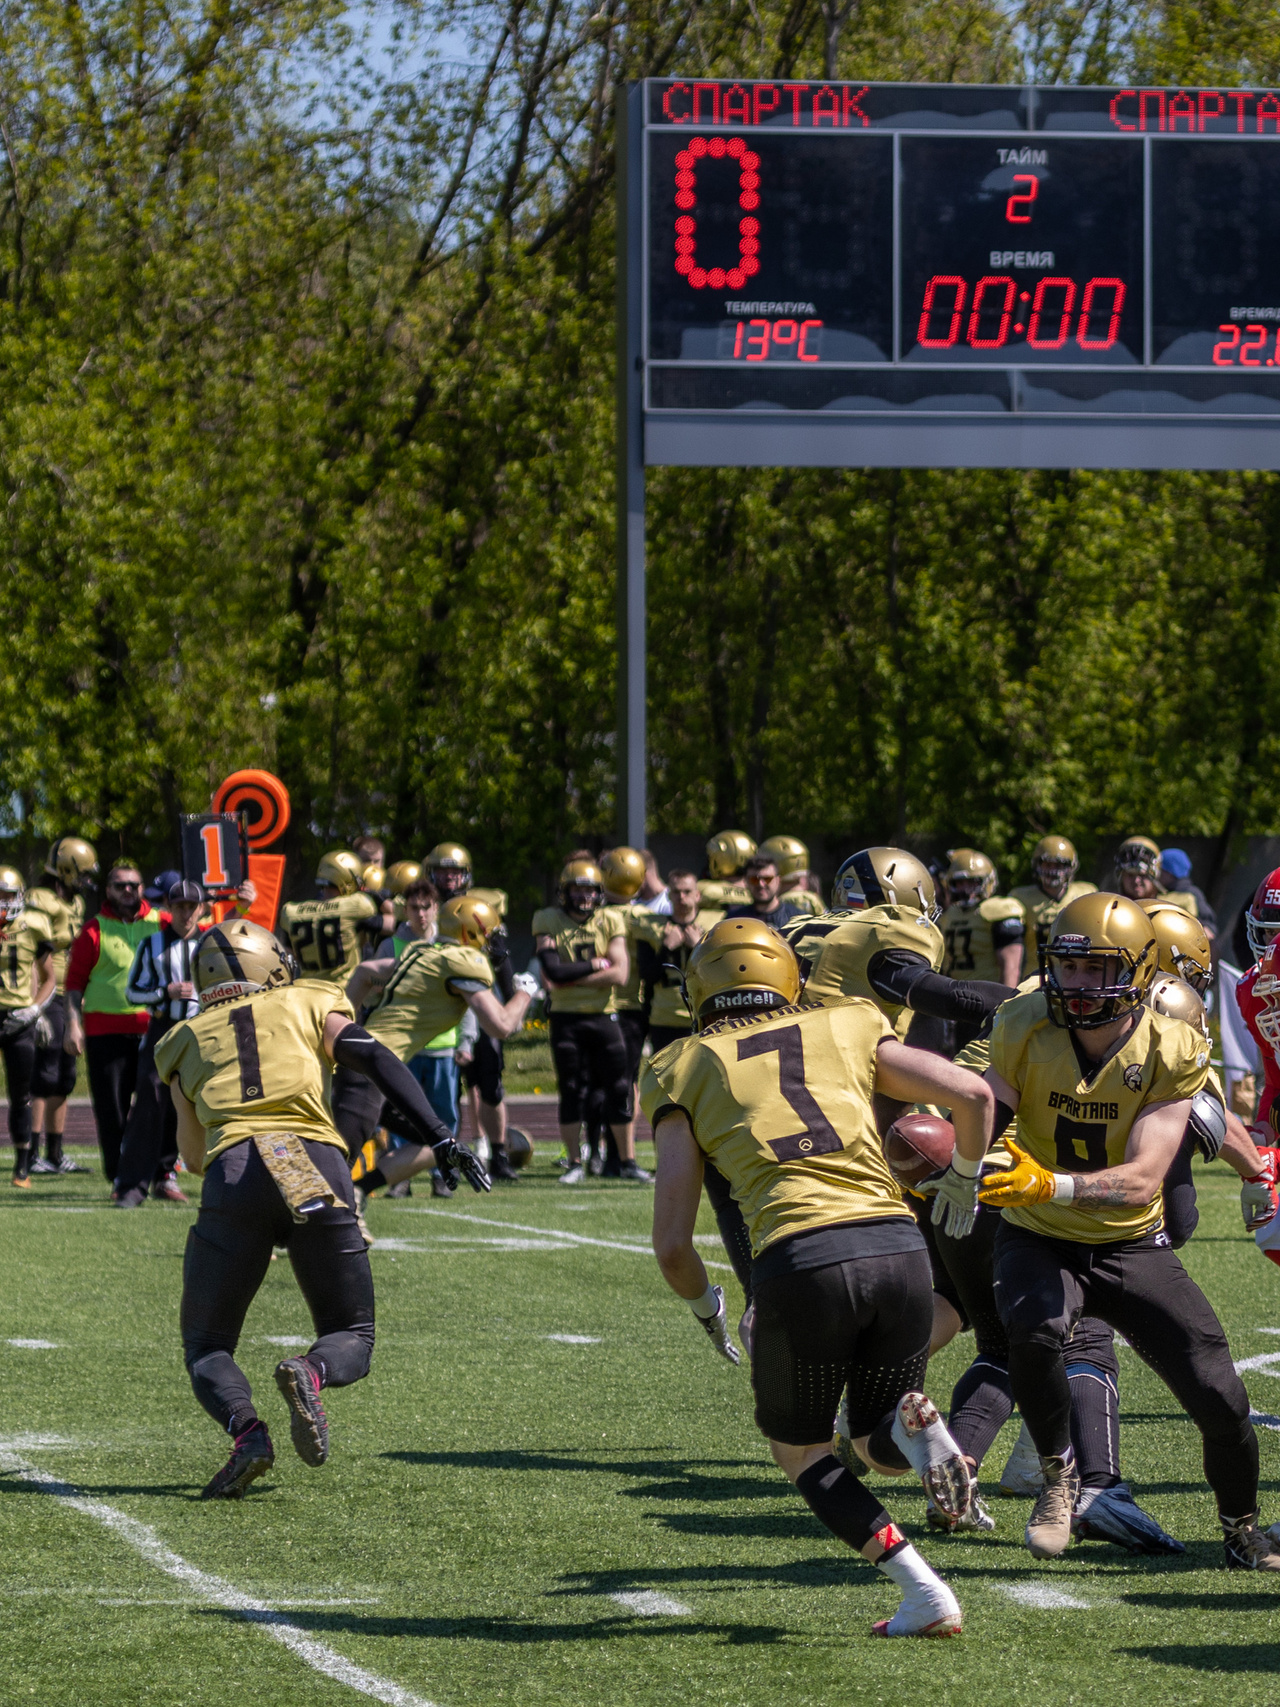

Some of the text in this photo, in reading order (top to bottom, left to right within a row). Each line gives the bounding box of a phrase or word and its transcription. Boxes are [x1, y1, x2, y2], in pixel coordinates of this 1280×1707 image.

[662, 82, 870, 127] СПАРТАК
[996, 146, 1048, 165] ТАЙМ
[674, 137, 761, 290] 0
[1005, 174, 1039, 223] 2
[989, 251, 1055, 268] ВРЕМЯ
[724, 301, 818, 315] ТЕМПЕРАТУРА
[917, 275, 1127, 350] 00:00
[199, 822, 230, 887] 1
[291, 916, 345, 971] 28
[201, 984, 243, 1004] Riddell
[713, 992, 773, 1008] Riddell
[227, 1004, 265, 1103] 1
[1048, 1091, 1119, 1120] SPARTANS
